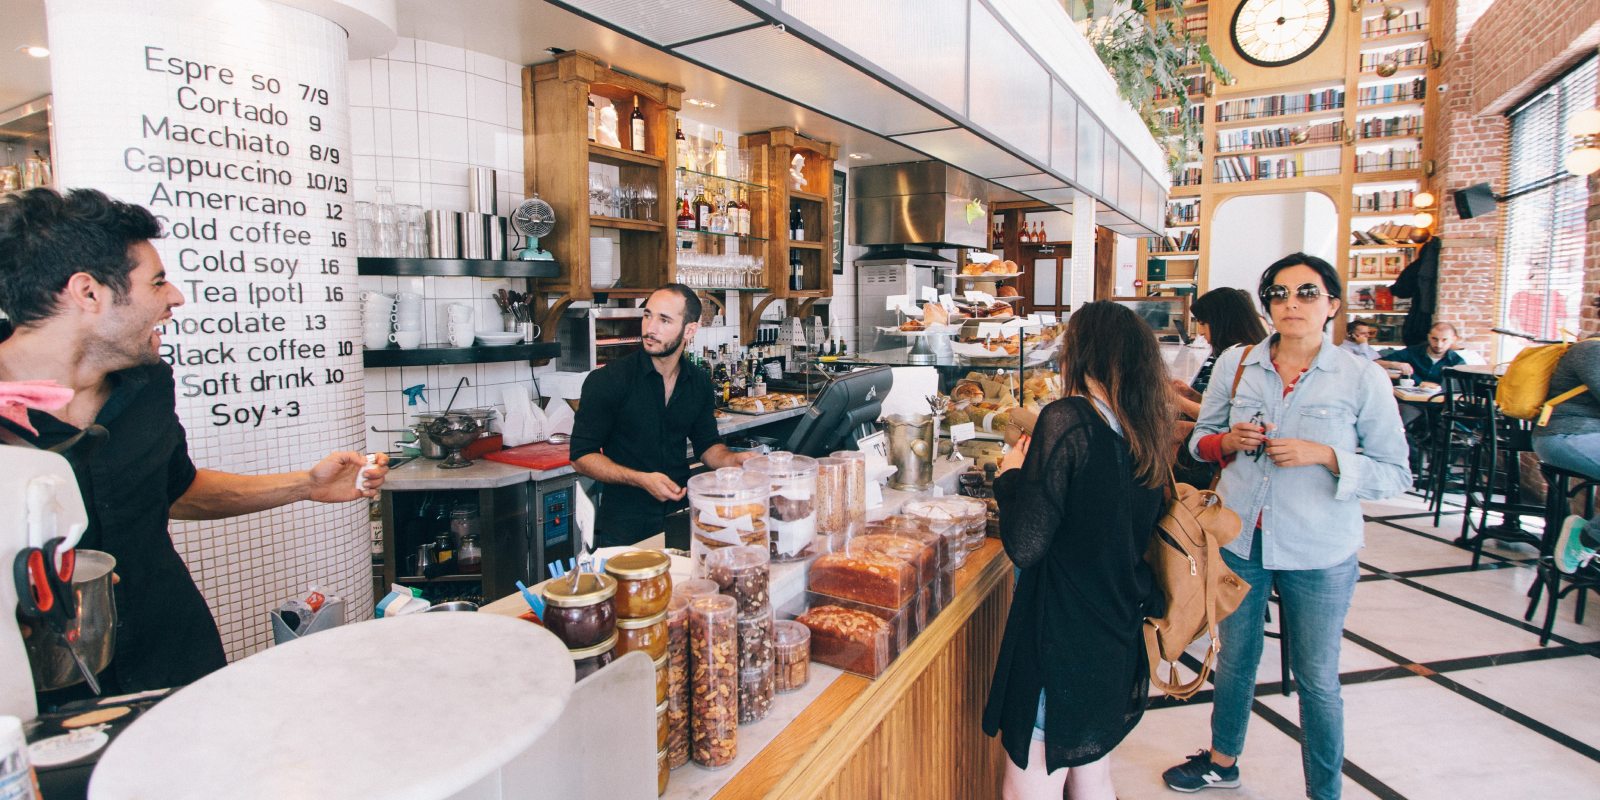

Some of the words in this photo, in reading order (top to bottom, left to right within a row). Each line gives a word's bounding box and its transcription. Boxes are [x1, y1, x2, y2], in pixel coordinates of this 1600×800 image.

[177, 86, 288, 126] Cortado
[309, 116, 321, 131] 9
[298, 84, 328, 105] 7/9
[142, 114, 290, 156] Macchiato
[310, 145, 339, 164] 8/9
[124, 147, 292, 186] Cappuccino
[307, 172, 348, 194] 10/13
[149, 182, 306, 216] Americano
[326, 203, 343, 220] 12
[153, 214, 217, 240] Cold
[230, 221, 311, 245] coffee
[332, 231, 347, 248] 16
[179, 248, 245, 273] Cold
[254, 257, 298, 279] soy
[320, 259, 339, 275] 16
[184, 279, 237, 303] Tea
[325, 286, 344, 302] 16
[156, 312, 286, 335] hocolate
[305, 315, 326, 331] 13
[160, 342, 236, 366] Black
[247, 339, 326, 362] coffee
[338, 341, 353, 356] 10
[182, 372, 241, 398] Soft
[250, 367, 315, 392] drink
[325, 368, 344, 384] 10
